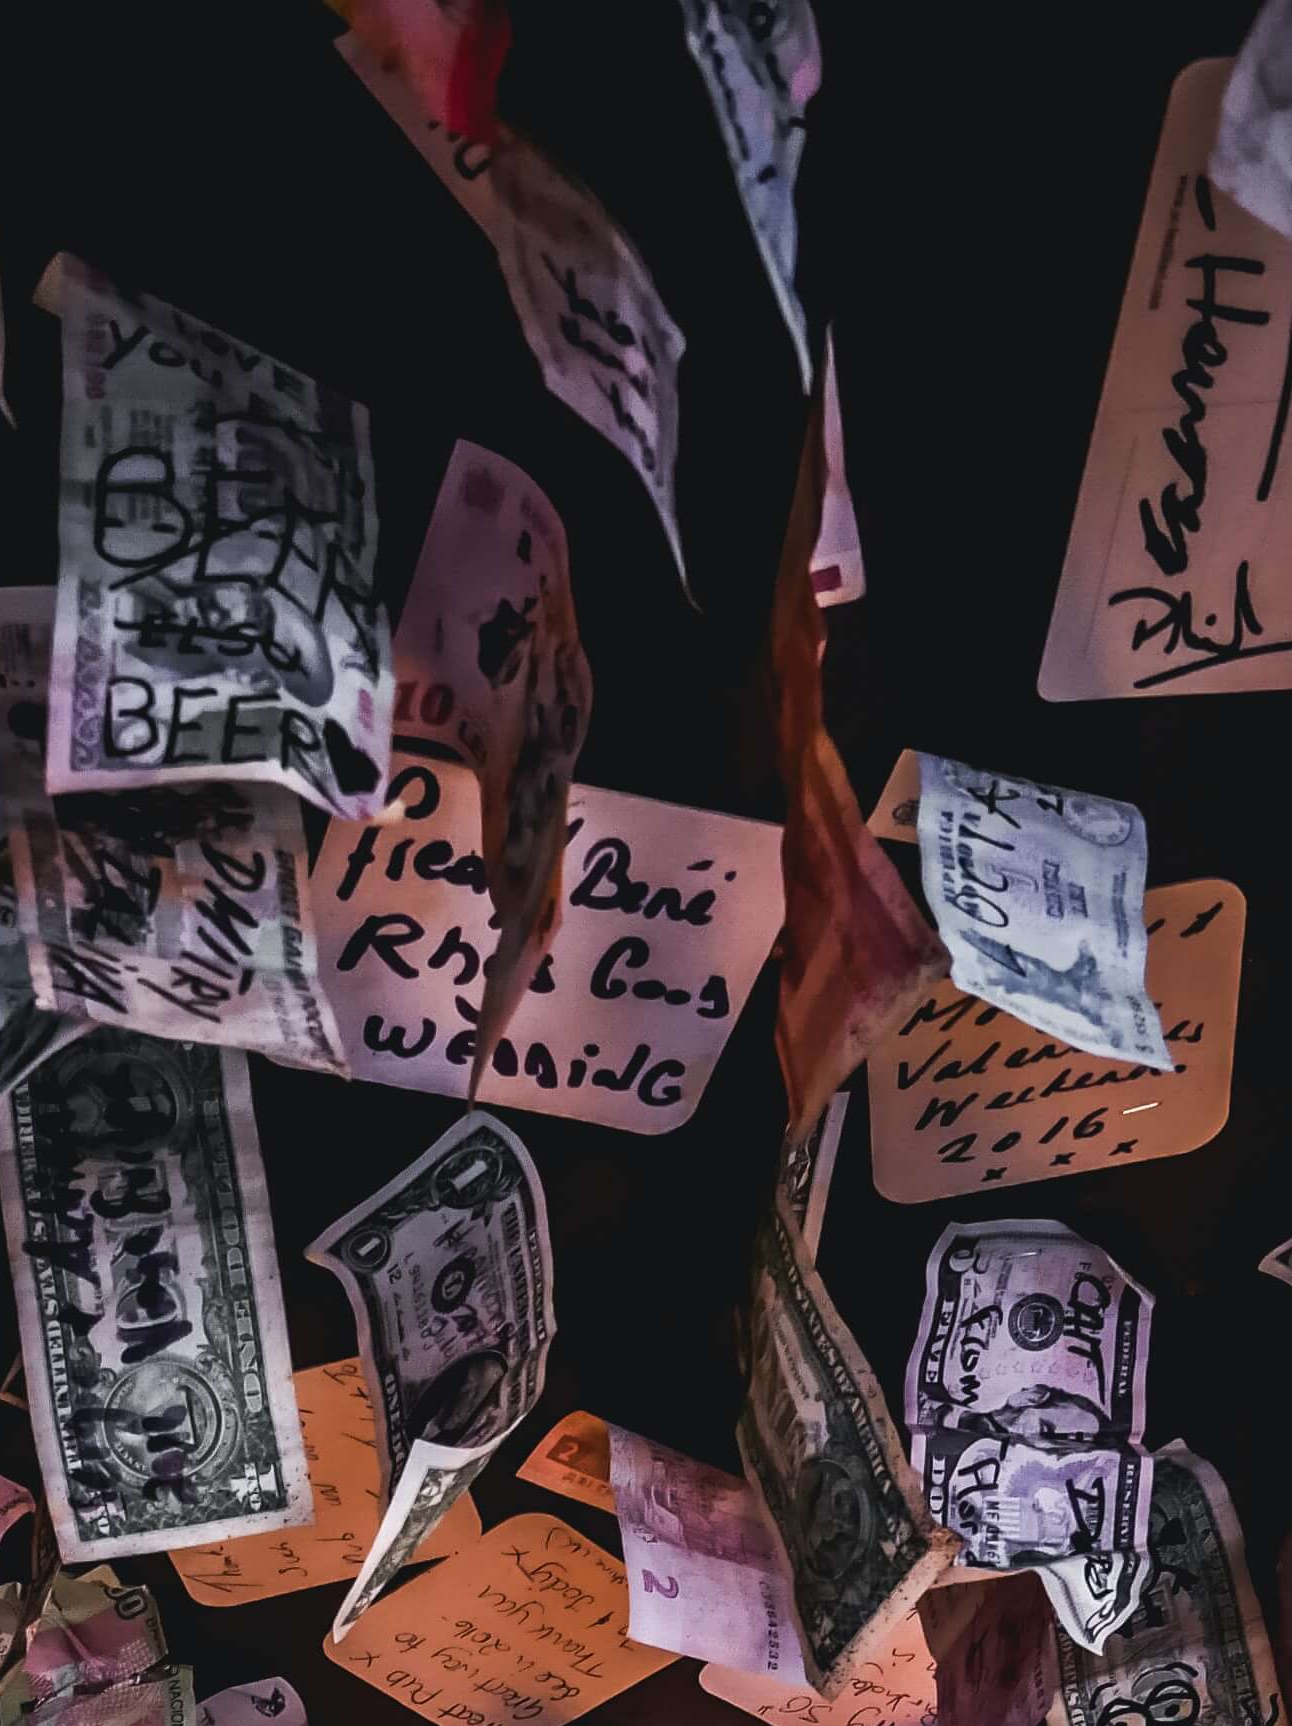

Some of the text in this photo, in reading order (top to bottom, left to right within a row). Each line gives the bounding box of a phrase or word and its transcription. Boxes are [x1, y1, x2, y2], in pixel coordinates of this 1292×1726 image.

[108, 678, 321, 767] BEER
[938, 1109, 1108, 1163] 2016
[923, 1300, 955, 1386] FIVE
[644, 1569, 677, 1599] 2
[475, 1586, 603, 1679] Thank you
[394, 1632, 543, 1721] Great way to
